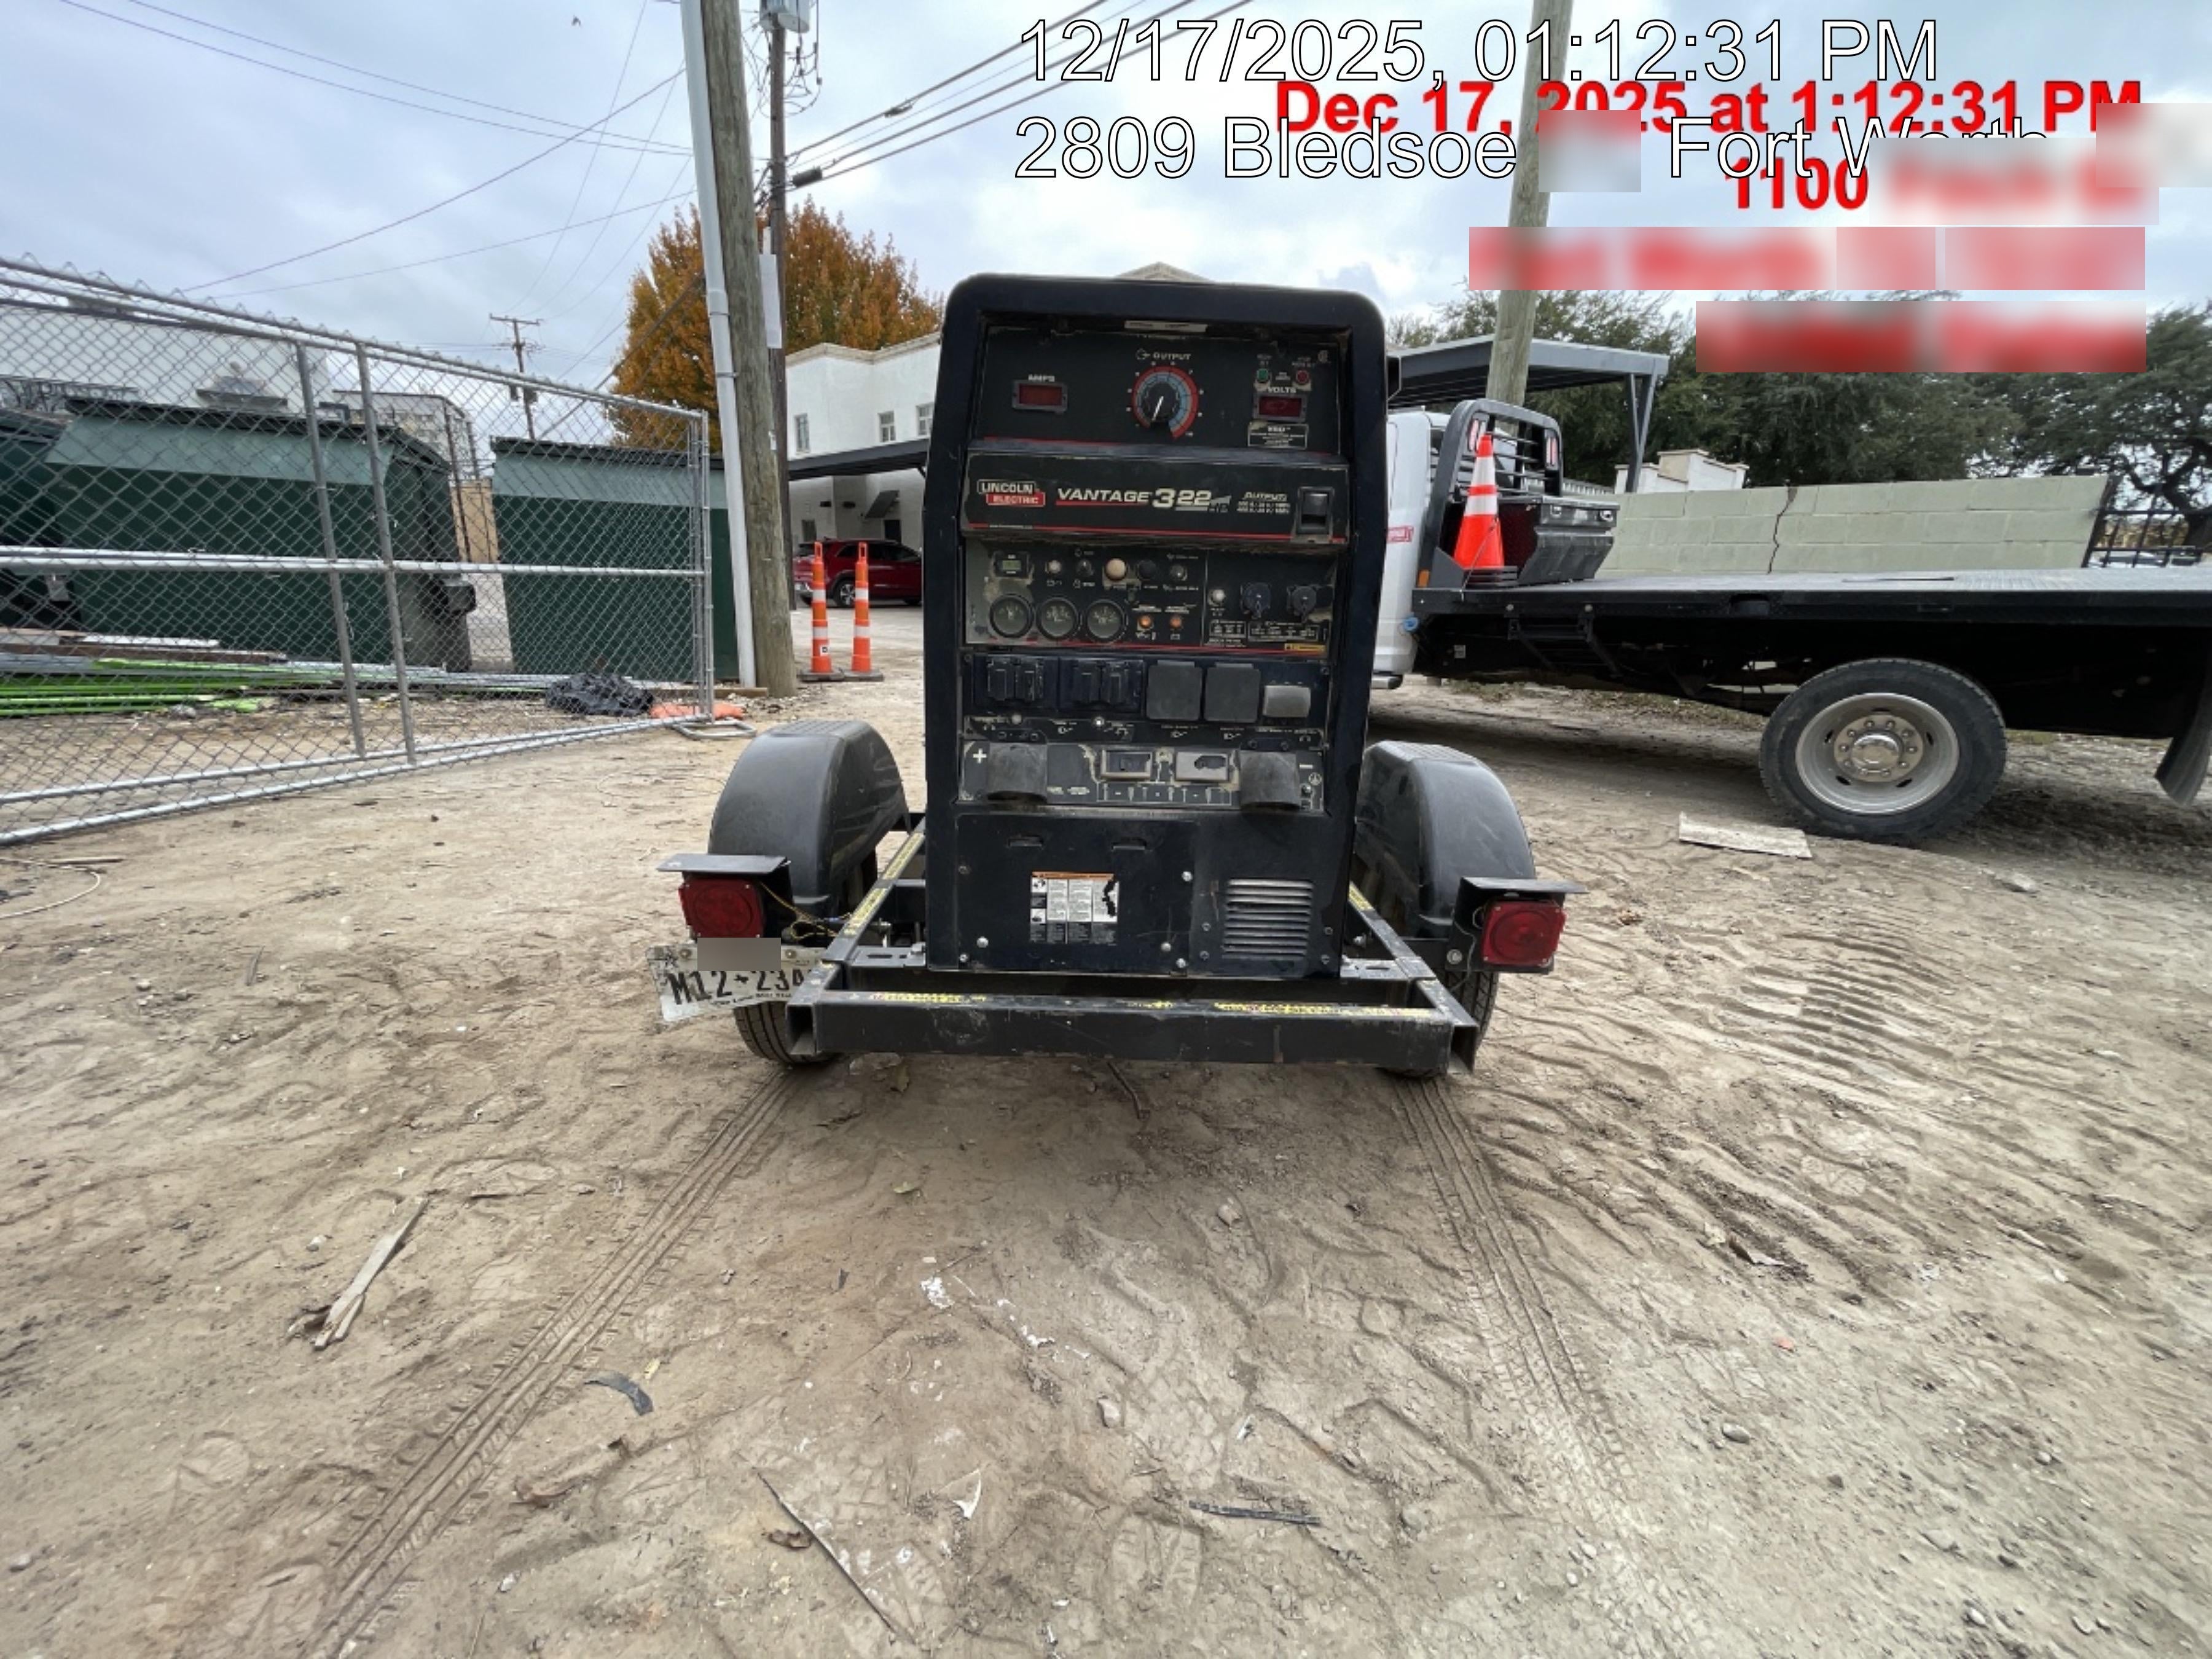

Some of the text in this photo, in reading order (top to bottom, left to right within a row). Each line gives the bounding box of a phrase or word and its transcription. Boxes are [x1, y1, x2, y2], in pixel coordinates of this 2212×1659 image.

[981, 482, 1033, 494] LINCOLN
[992, 495, 1039, 504] ELECTRIC
[1057, 488, 1212, 508] VANTAGE 322
